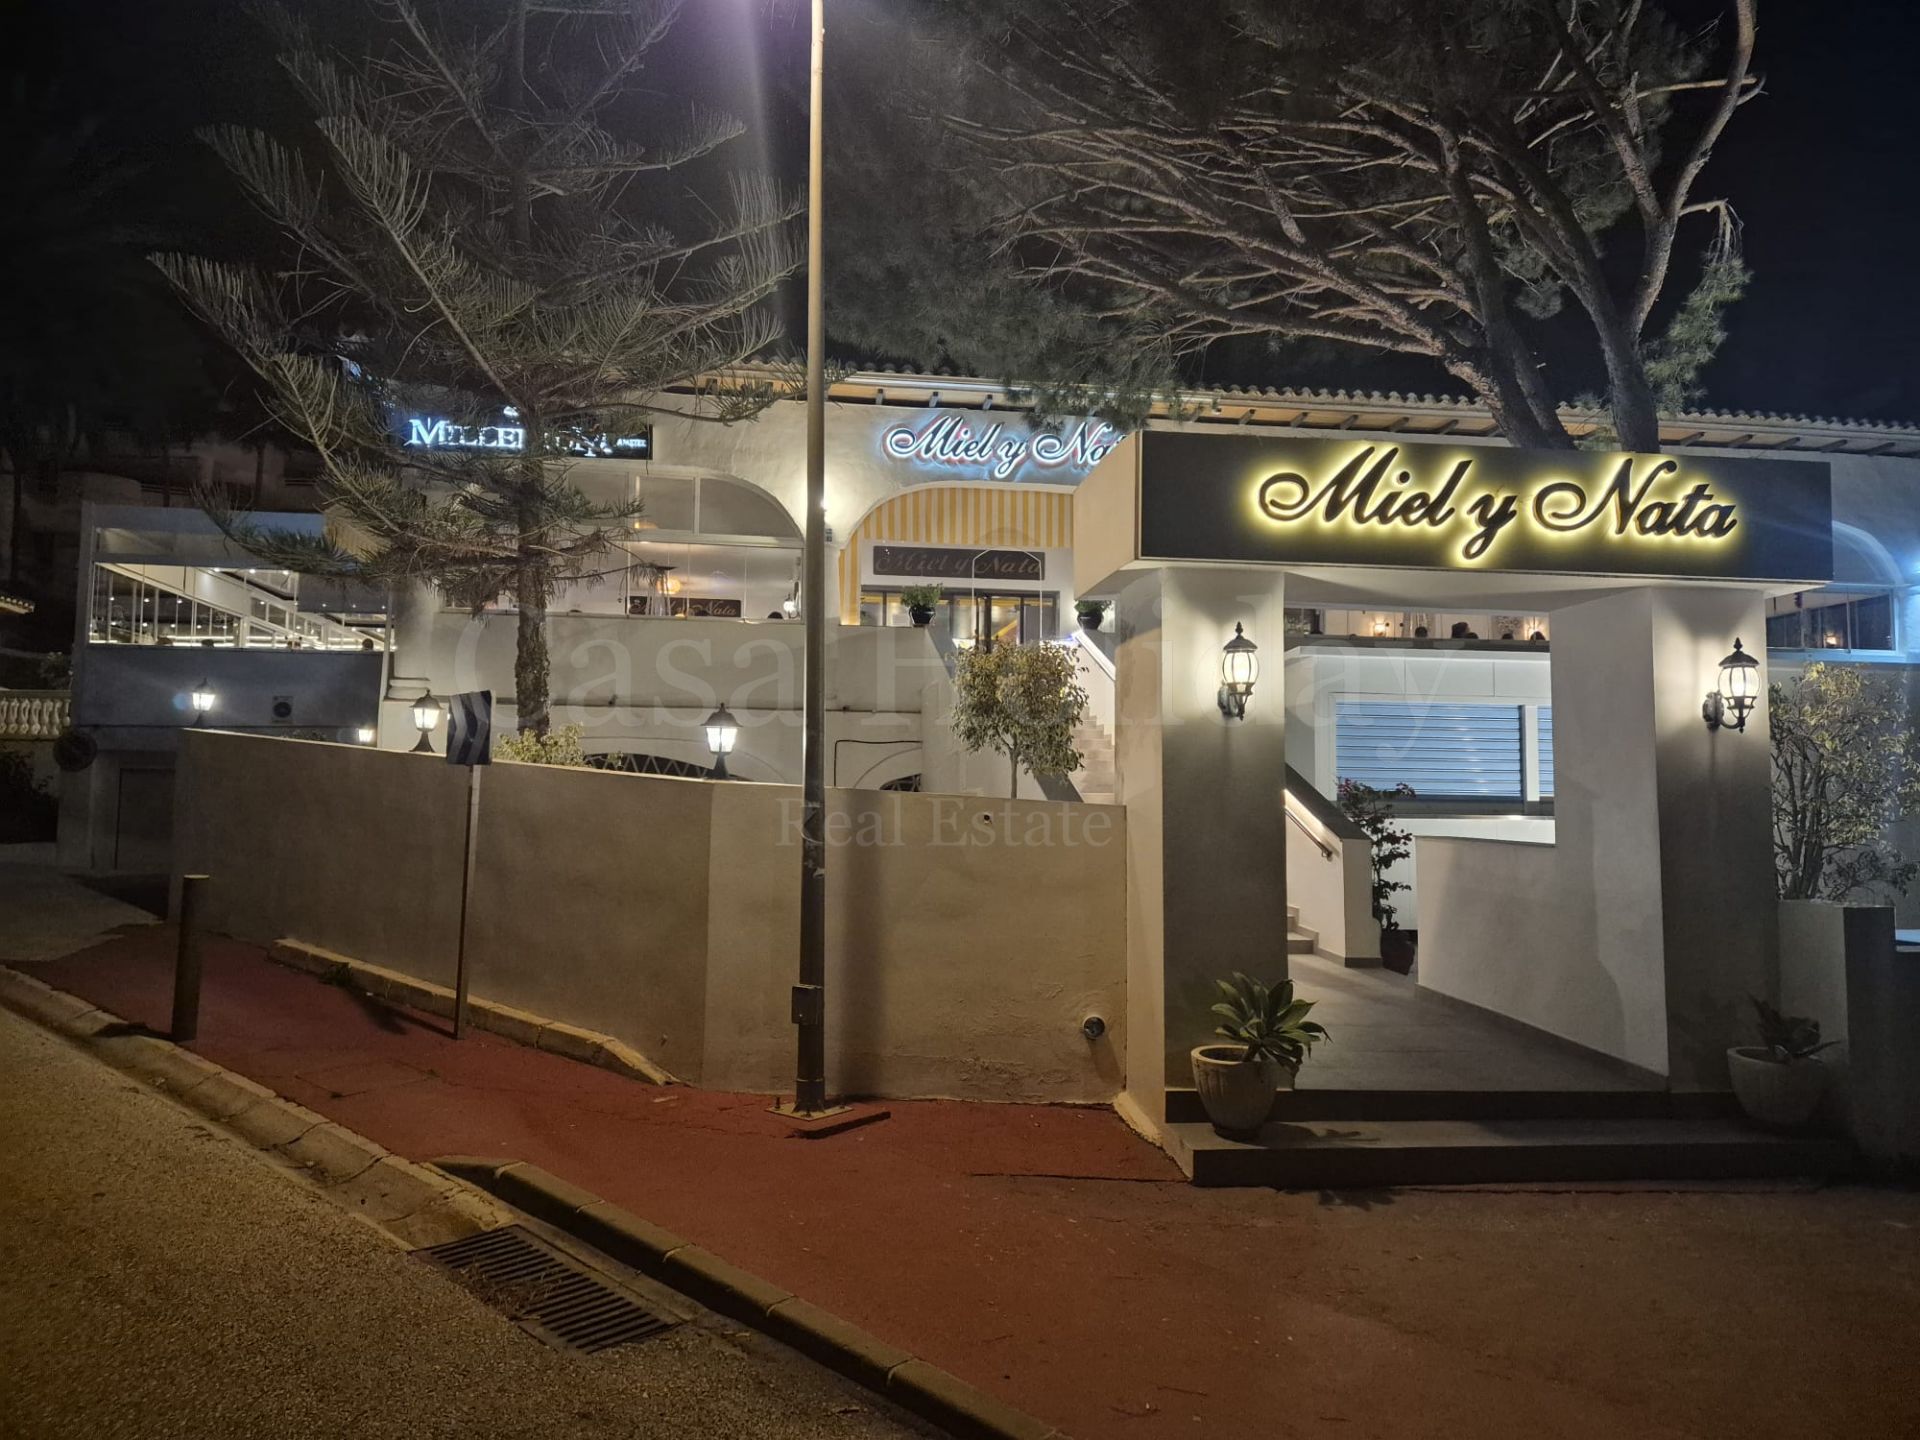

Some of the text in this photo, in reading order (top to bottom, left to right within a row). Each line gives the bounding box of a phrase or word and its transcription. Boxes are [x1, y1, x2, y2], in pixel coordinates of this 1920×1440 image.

[887, 414, 1127, 479] Miel y Na
[1258, 445, 1738, 560] Miel y Nata
[876, 550, 948, 572] Miel
[974, 555, 1042, 575] Nata
